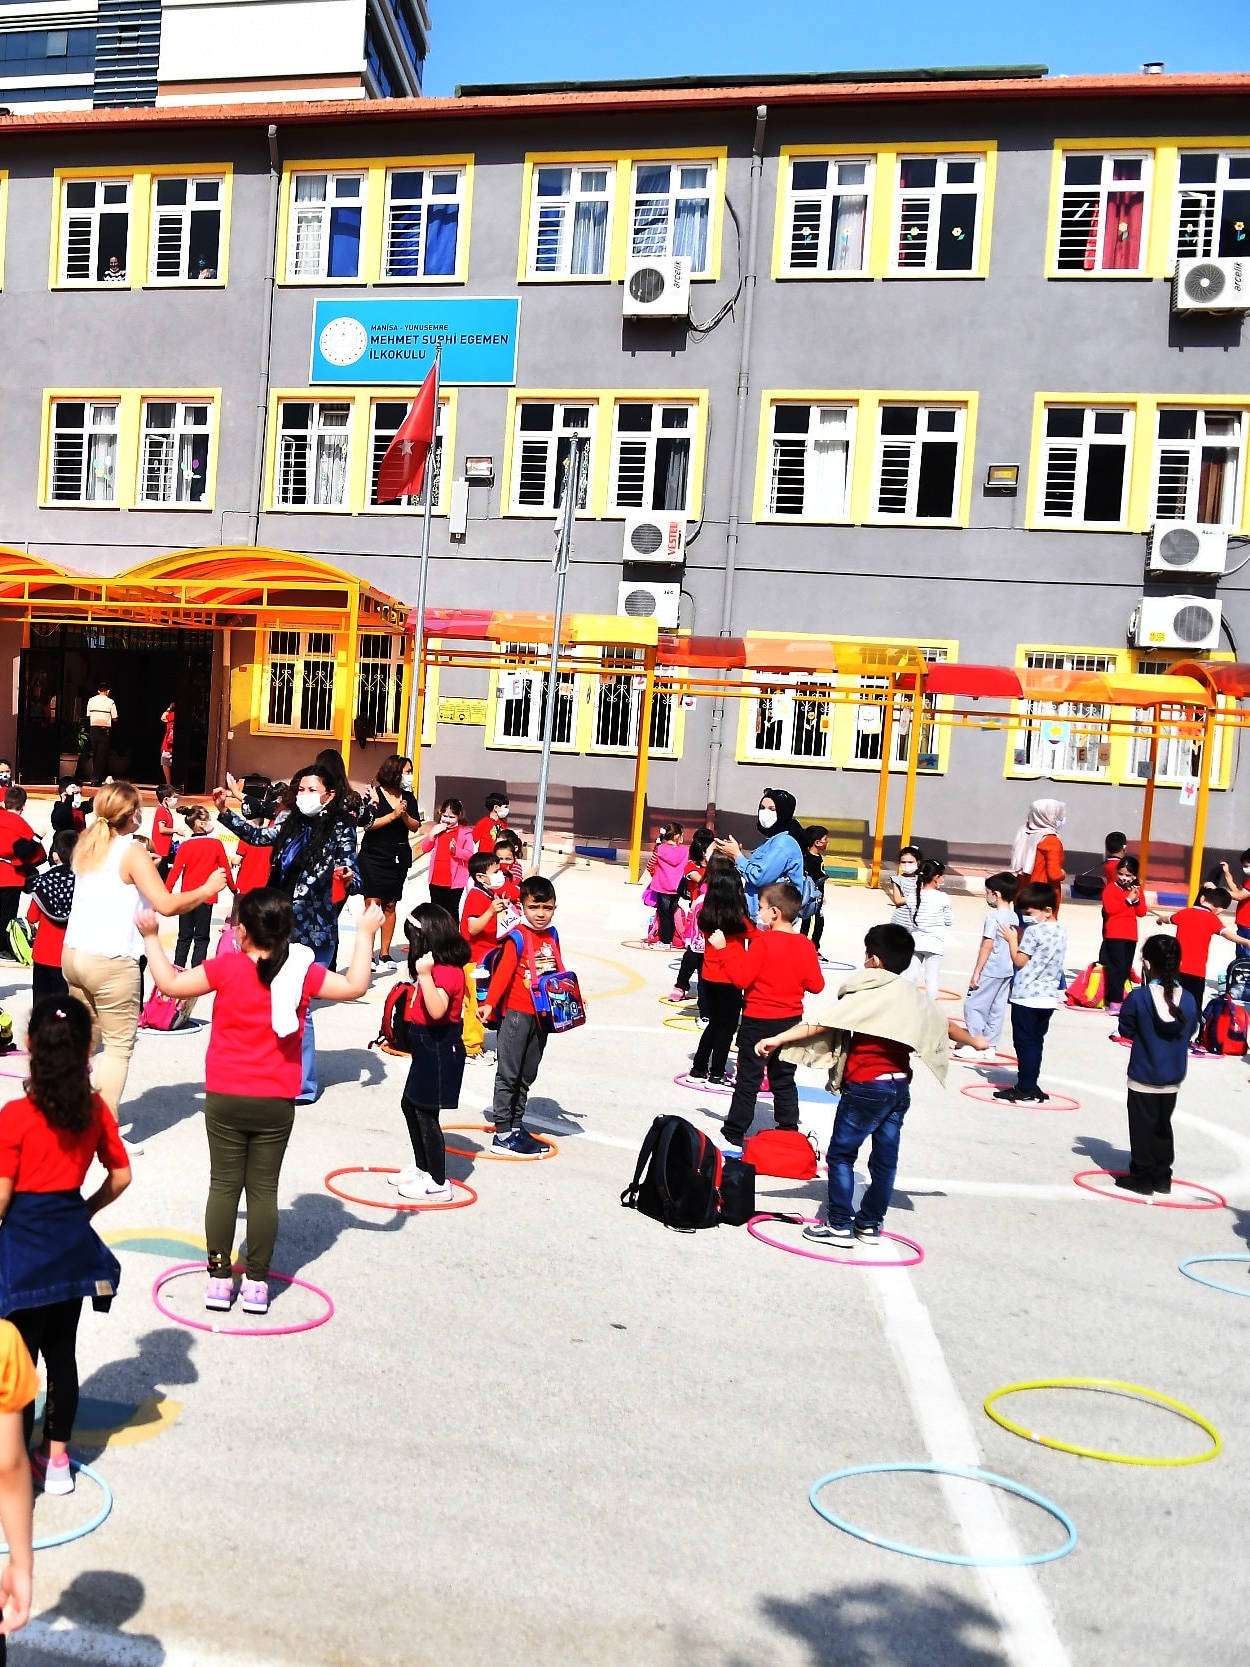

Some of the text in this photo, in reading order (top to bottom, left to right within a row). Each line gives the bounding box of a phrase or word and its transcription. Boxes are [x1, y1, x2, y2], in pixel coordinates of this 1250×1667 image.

[370, 332, 508, 345] MEHMET SUPHİ EGEMEN
[369, 347, 426, 359] İLKOKULU
[667, 523, 678, 556] VESTEL
